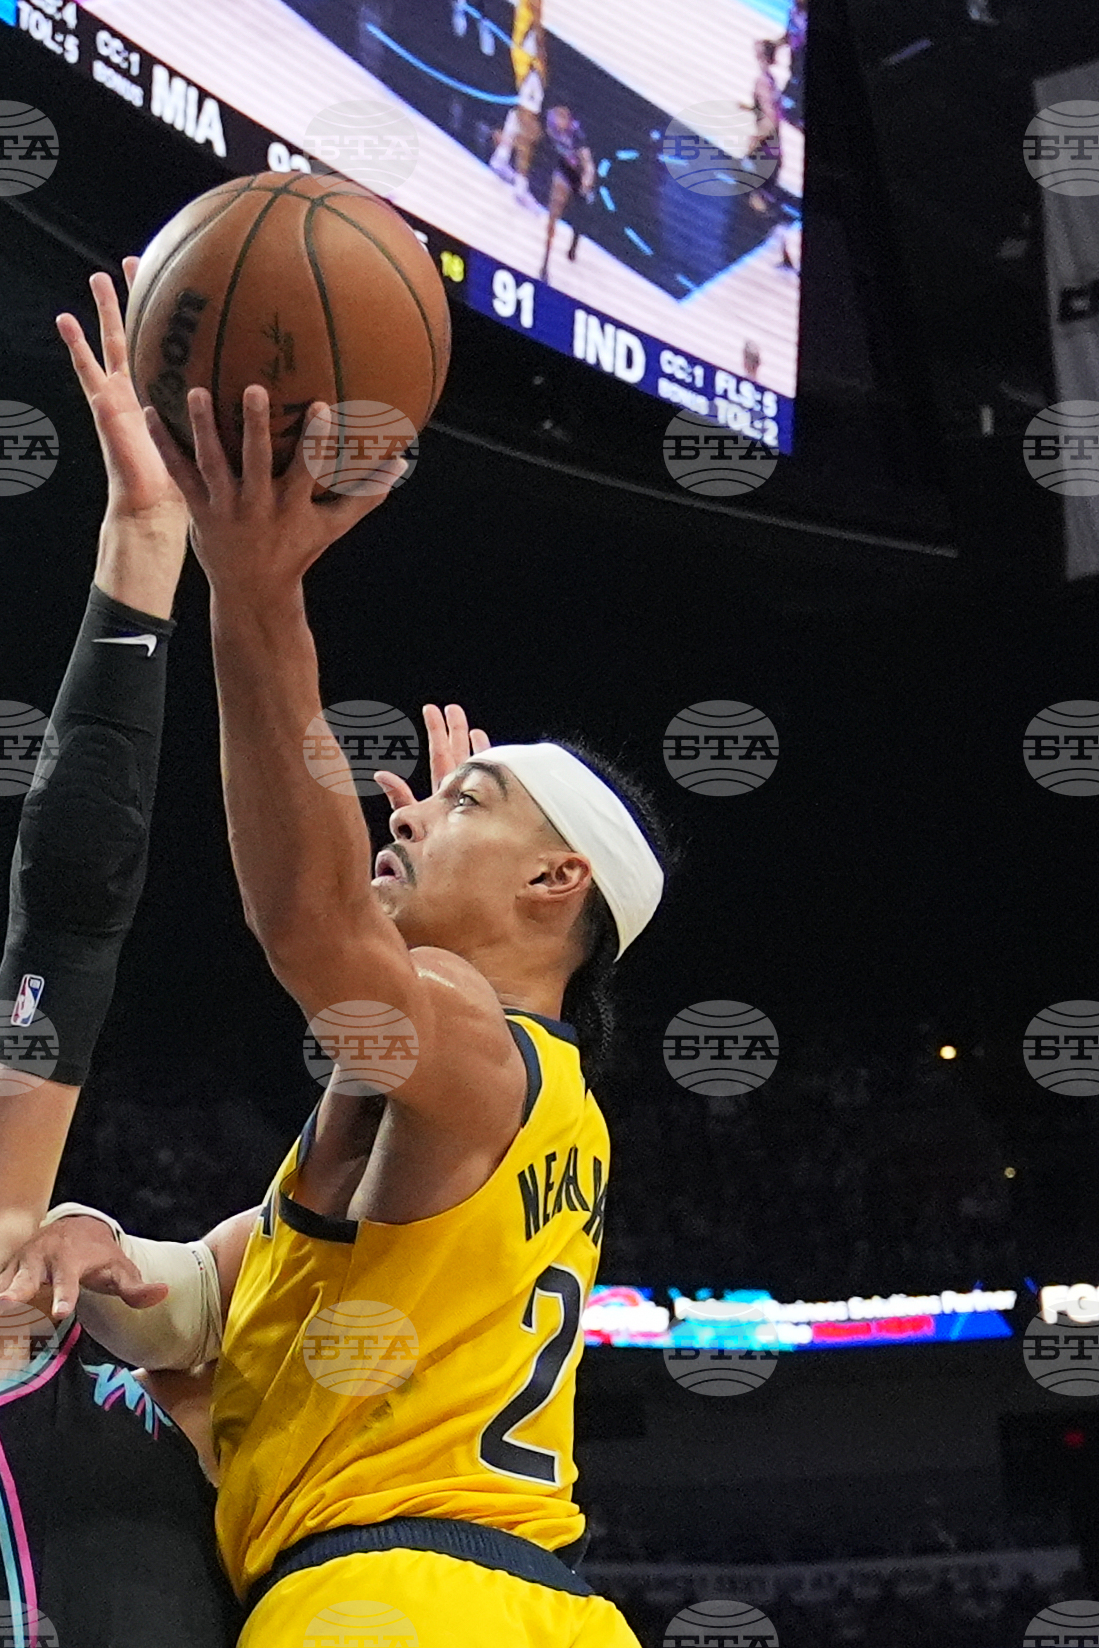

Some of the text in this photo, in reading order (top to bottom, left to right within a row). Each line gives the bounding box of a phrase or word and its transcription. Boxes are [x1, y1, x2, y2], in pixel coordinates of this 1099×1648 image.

[152, 63, 226, 158] MIA
[492, 269, 535, 329] 91
[573, 309, 646, 384] IND
[478, 1262, 586, 1488] 2
